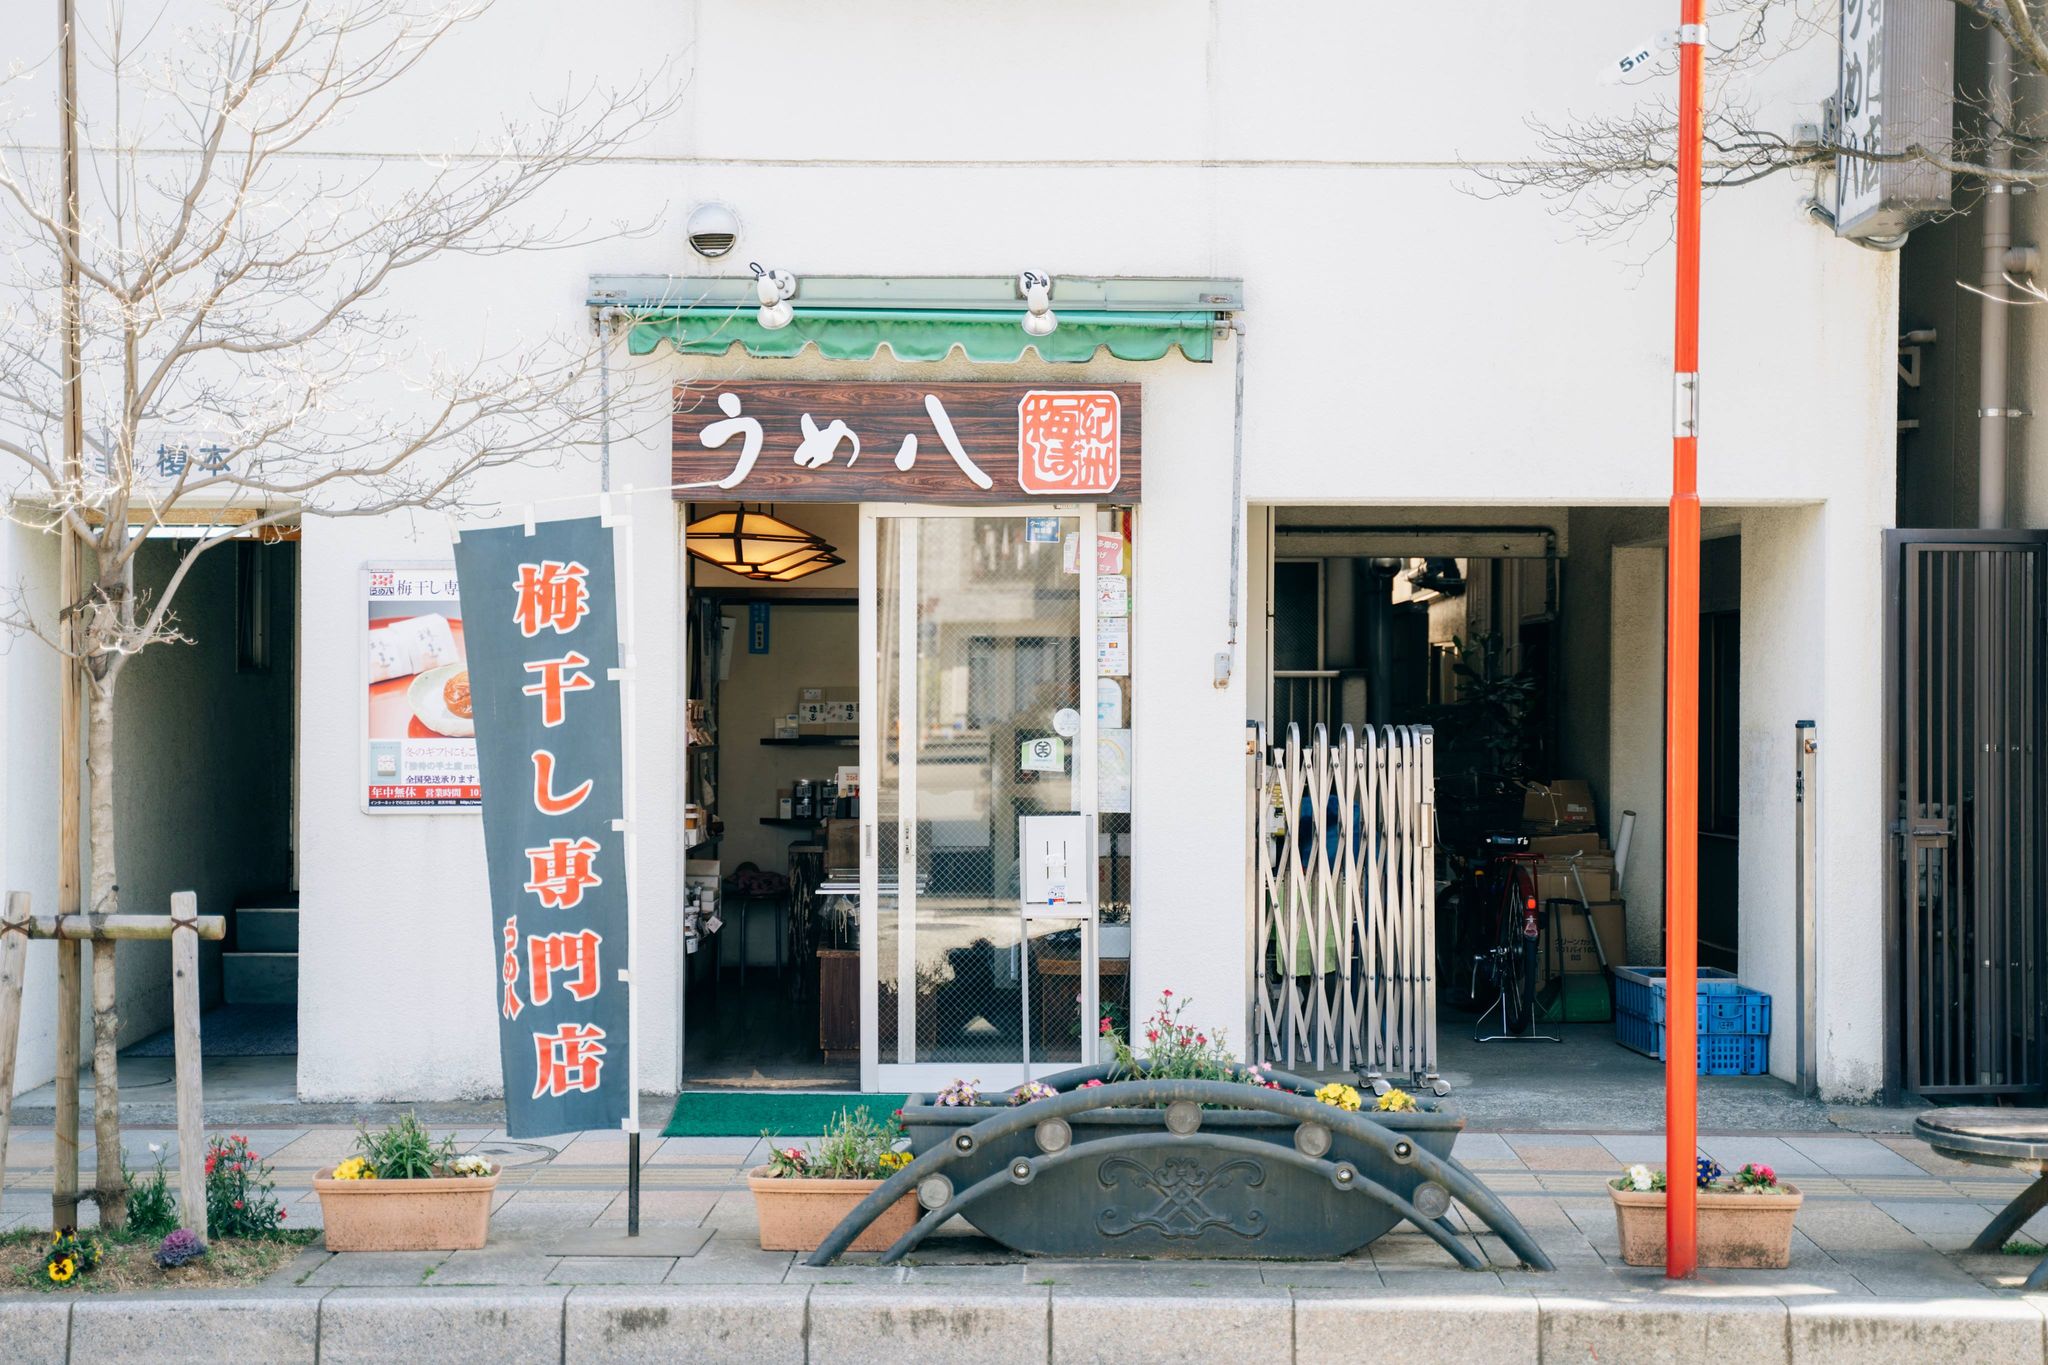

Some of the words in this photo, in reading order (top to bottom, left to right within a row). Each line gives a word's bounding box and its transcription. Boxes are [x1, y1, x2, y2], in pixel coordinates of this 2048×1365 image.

[700, 393, 993, 489] うめ八
[371, 787, 416, 798] 年中無休
[425, 788, 461, 797] 営業時間
[406, 775, 475, 784] 全国発送承ります
[512, 560, 607, 1100] 梅干し専門店
[502, 915, 525, 1020] うめ八
